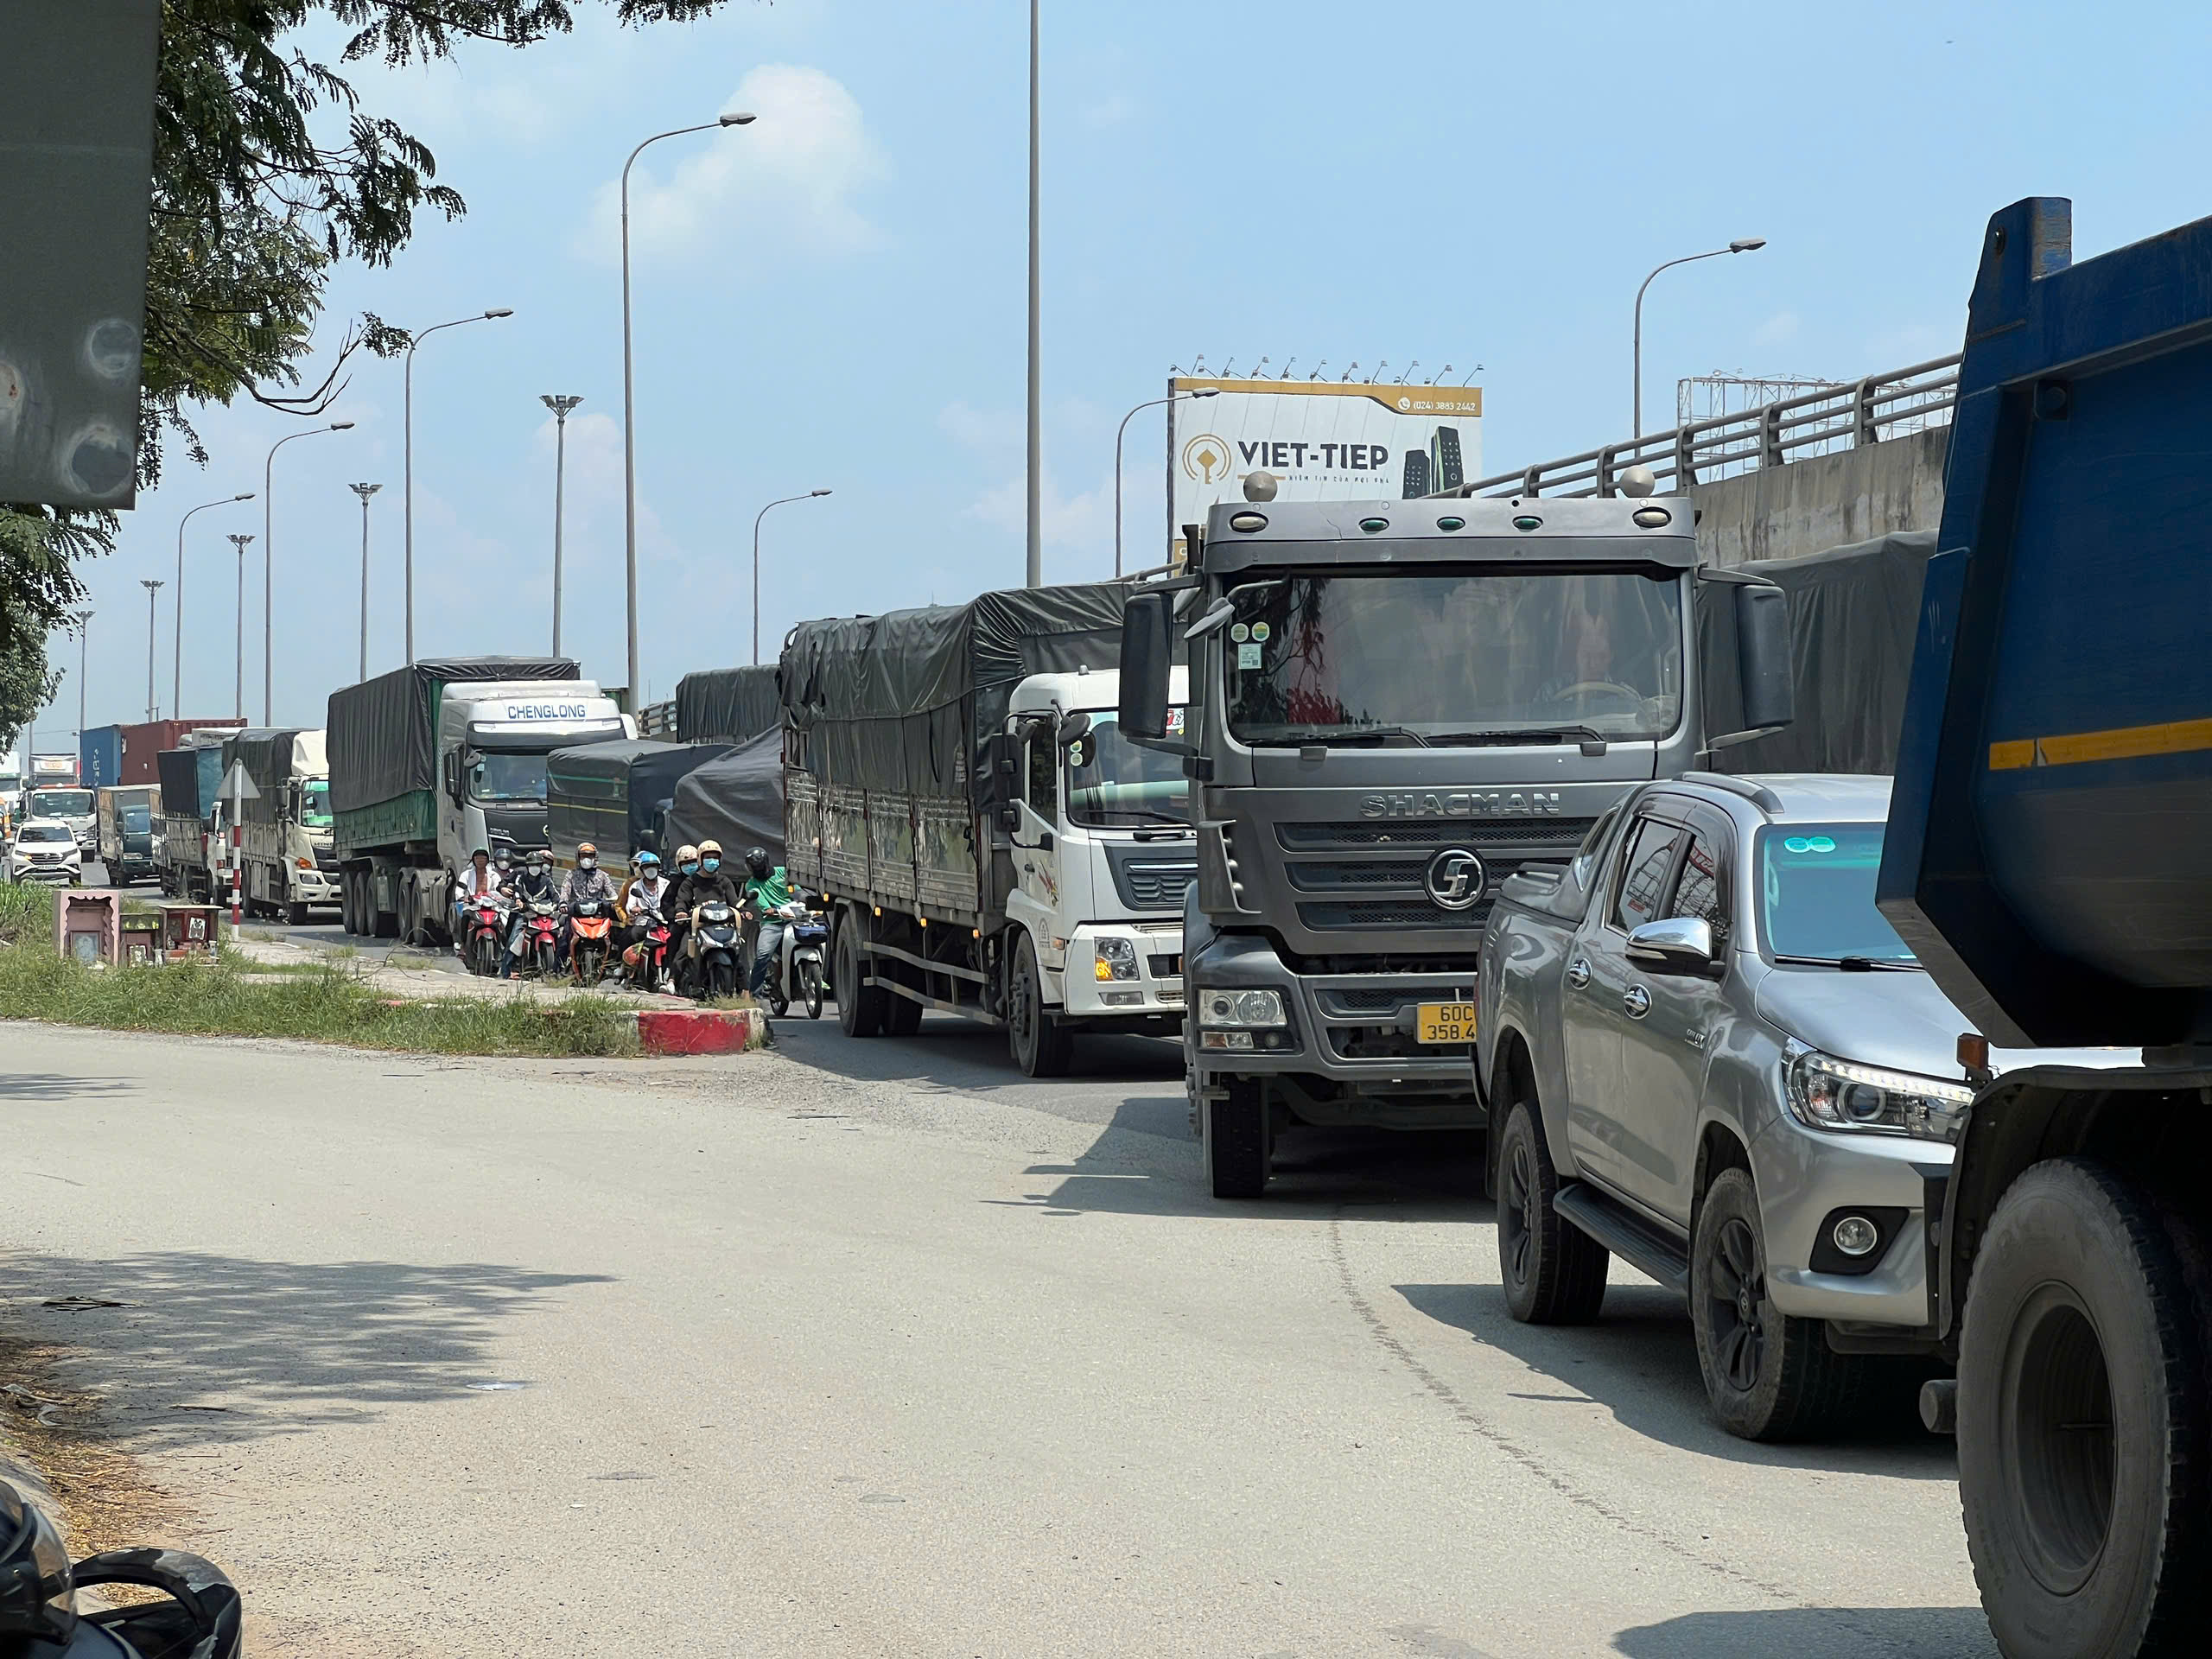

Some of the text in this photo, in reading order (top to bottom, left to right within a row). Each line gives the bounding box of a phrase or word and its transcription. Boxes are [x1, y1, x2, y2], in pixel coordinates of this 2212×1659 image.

[1413, 401, 1433, 410] (024)
[1435, 401, 1454, 410] 3883
[1237, 441, 1389, 470] VIET-TIEP
[508, 704, 586, 719] CHENGLONG
[1360, 793, 1560, 817] SHACMAN
[1440, 1006, 1473, 1021] 60C
[1427, 1024, 1475, 1039] 358.4
